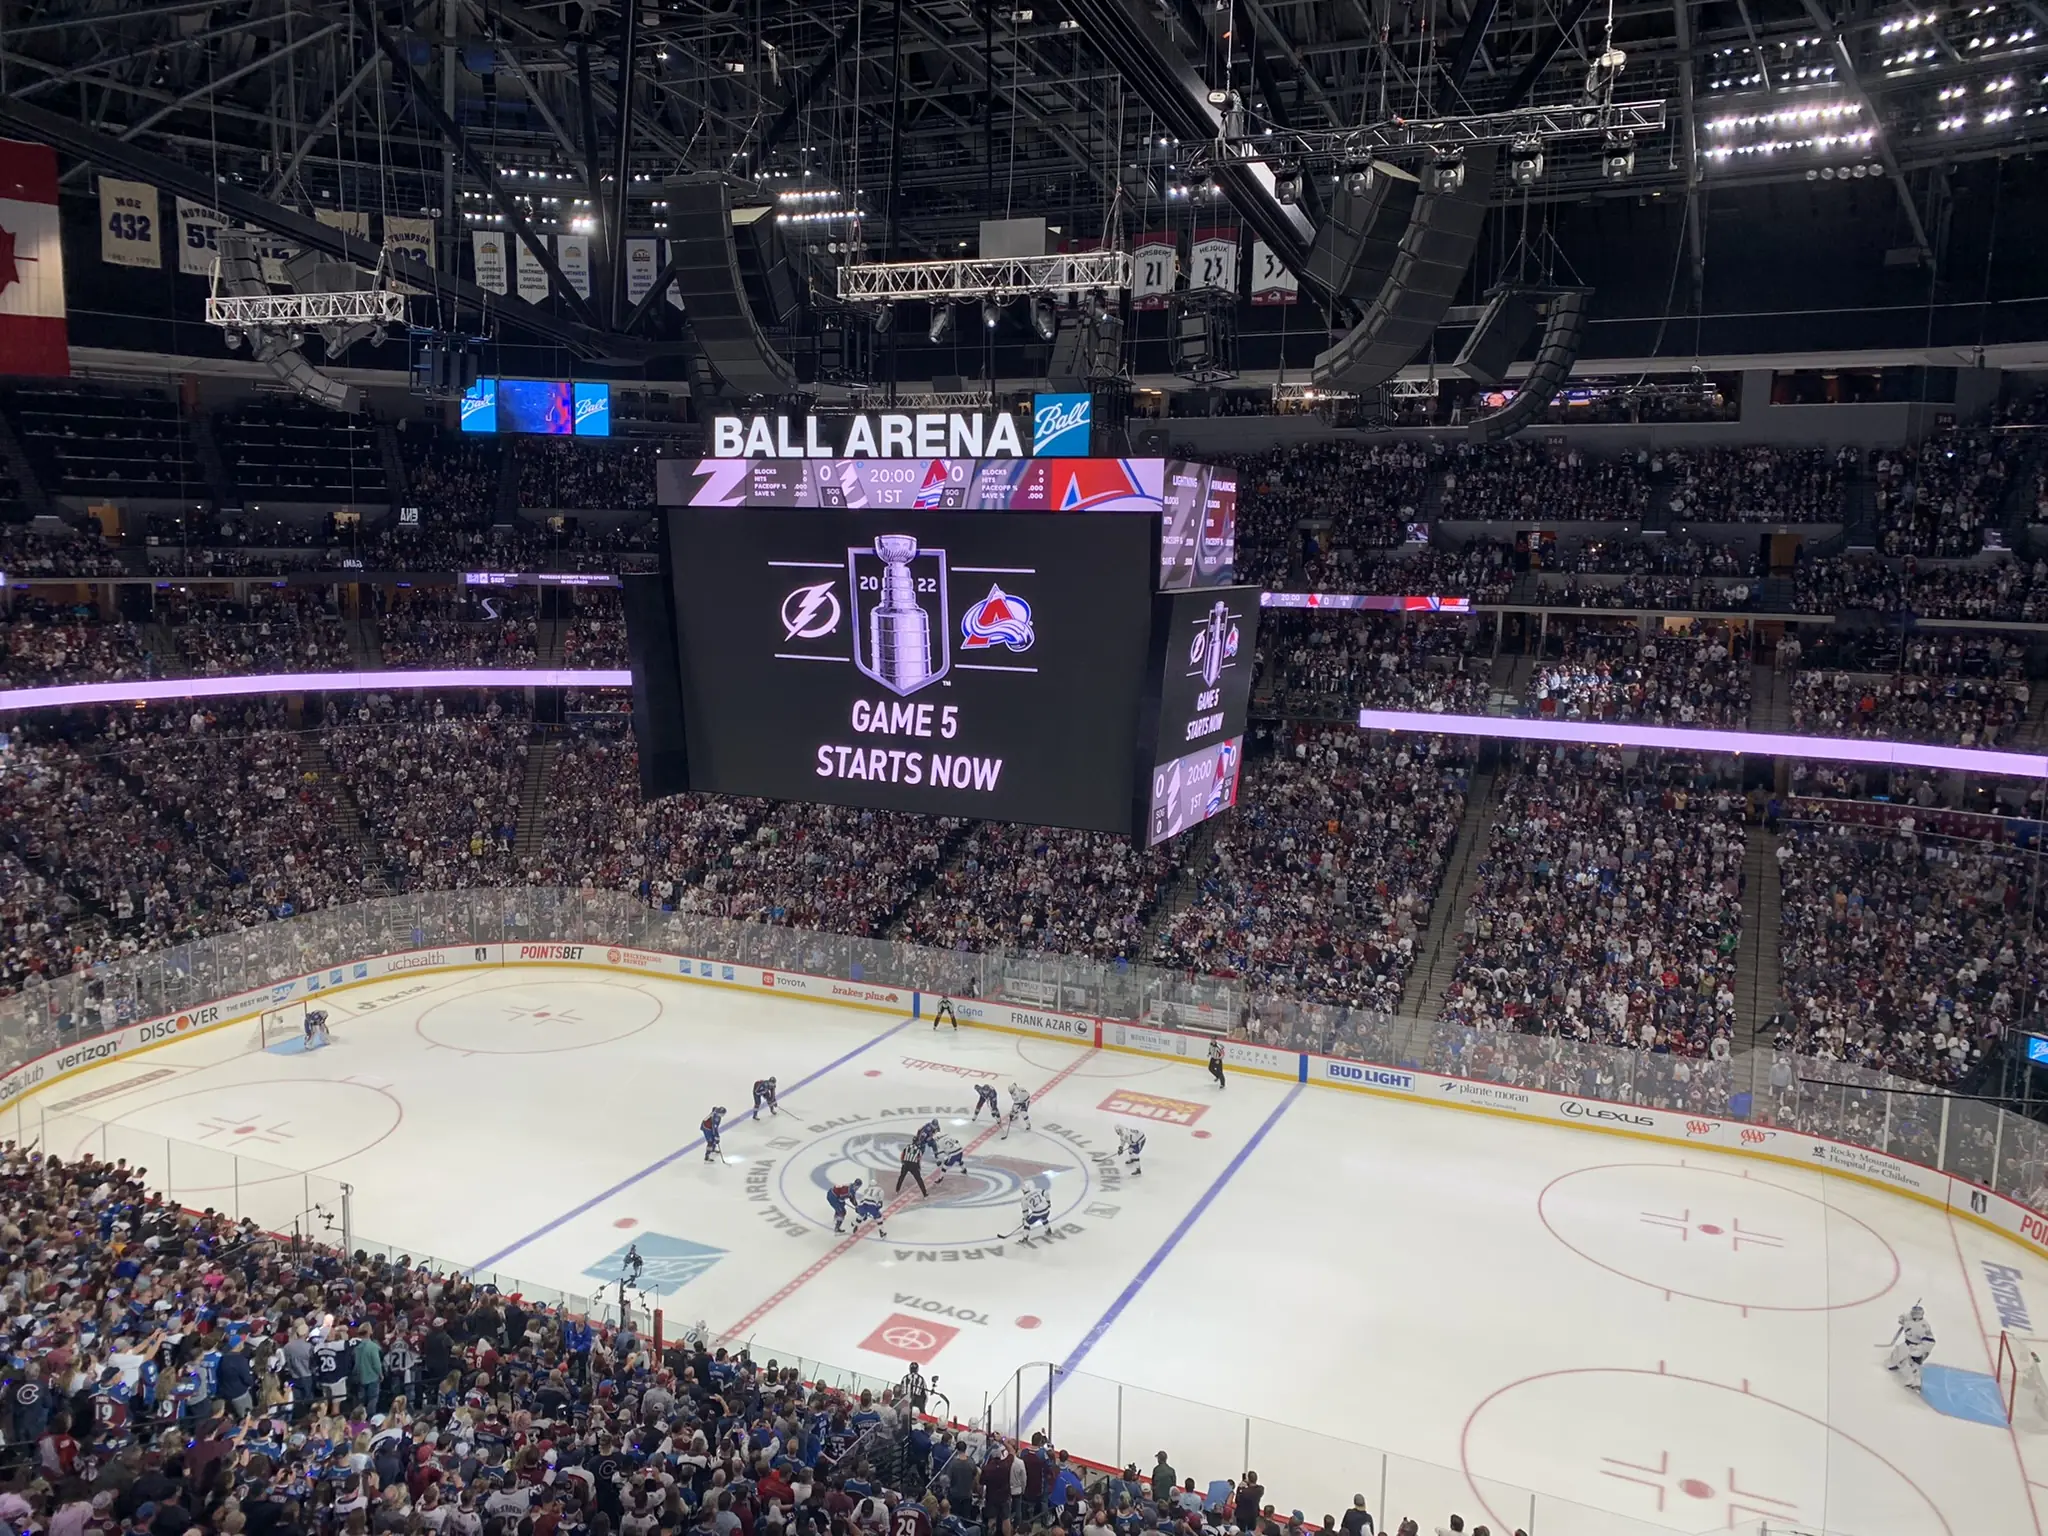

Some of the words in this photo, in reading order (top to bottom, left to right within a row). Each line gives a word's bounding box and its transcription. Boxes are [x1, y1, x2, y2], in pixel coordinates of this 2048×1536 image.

[115, 197, 141, 209] MOE
[109, 212, 151, 242] 432
[1135, 250, 1171, 260] FORSBERG
[1146, 261, 1161, 286] 21
[1204, 255, 1223, 282] 23
[578, 398, 607, 415] Ball
[1036, 400, 1090, 439] Ball
[714, 415, 833, 458] BALL
[843, 413, 1023, 458] ARENA
[820, 465, 831, 481] 0
[870, 469, 915, 483] 20:00
[952, 466, 964, 481] 0
[832, 496, 839, 505] 0
[876, 490, 903, 503] 1ST
[947, 497, 954, 506] 0
[860, 576, 878, 591] 20
[917, 578, 937, 592] 22
[1197, 690, 1214, 711] GAME
[1213, 688, 1220, 707] 5
[852, 700, 934, 737] GAME
[941, 706, 958, 738] 5
[1186, 715, 1209, 741] STARTS
[1209, 712, 1225, 733] NOW
[816, 745, 922, 784] STARTS
[930, 754, 1002, 792] NOW
[1186, 759, 1212, 786] 20:00
[1155, 774, 1164, 799] 0
[1190, 792, 1203, 815] 1ST
[388, 951, 445, 972] uchealth
[520, 946, 584, 960] POINTSBET
[777, 977, 806, 988] TOYOTA
[240, 1000, 255, 1008] BEST
[256, 995, 270, 1003] RUN
[832, 985, 863, 1000] brakes
[865, 990, 885, 1002] plus
[957, 1004, 983, 1017] Cigna
[140, 1007, 219, 1042] DISCOVER
[1011, 1013, 1043, 1027] FRANK
[1045, 1018, 1071, 1032] AZAR
[57, 1041, 117, 1070] verizon
[1330, 1065, 1362, 1080] BUD
[1365, 1070, 1412, 1089] LIGHT
[1460, 1083, 1492, 1097] plante
[1495, 1090, 1528, 1103] moran
[808, 1113, 871, 1133] BALL
[880, 1106, 970, 1117] ARENA
[1108, 1100, 1191, 1122] KING
[1585, 1108, 1654, 1127] LEXUS
[1042, 1123, 1092, 1148] BALL
[1831, 1146, 1856, 1160] Rocky
[1860, 1153, 1901, 1171] Mountain
[746, 1159, 776, 1201] ARENA
[1829, 1155, 1865, 1170] Hospital
[1868, 1164, 1880, 1174] for
[1882, 1168, 1920, 1187] Children
[1029, 1194, 1042, 1208] 27
[757, 1205, 811, 1237] BALL
[893, 1245, 1004, 1262] ARENA
[893, 1293, 989, 1325] TOYOTA
[320, 1356, 336, 1372] 29
[390, 1352, 406, 1370] 21
[95, 1404, 113, 1420] 19
[896, 1518, 916, 1536] 29
